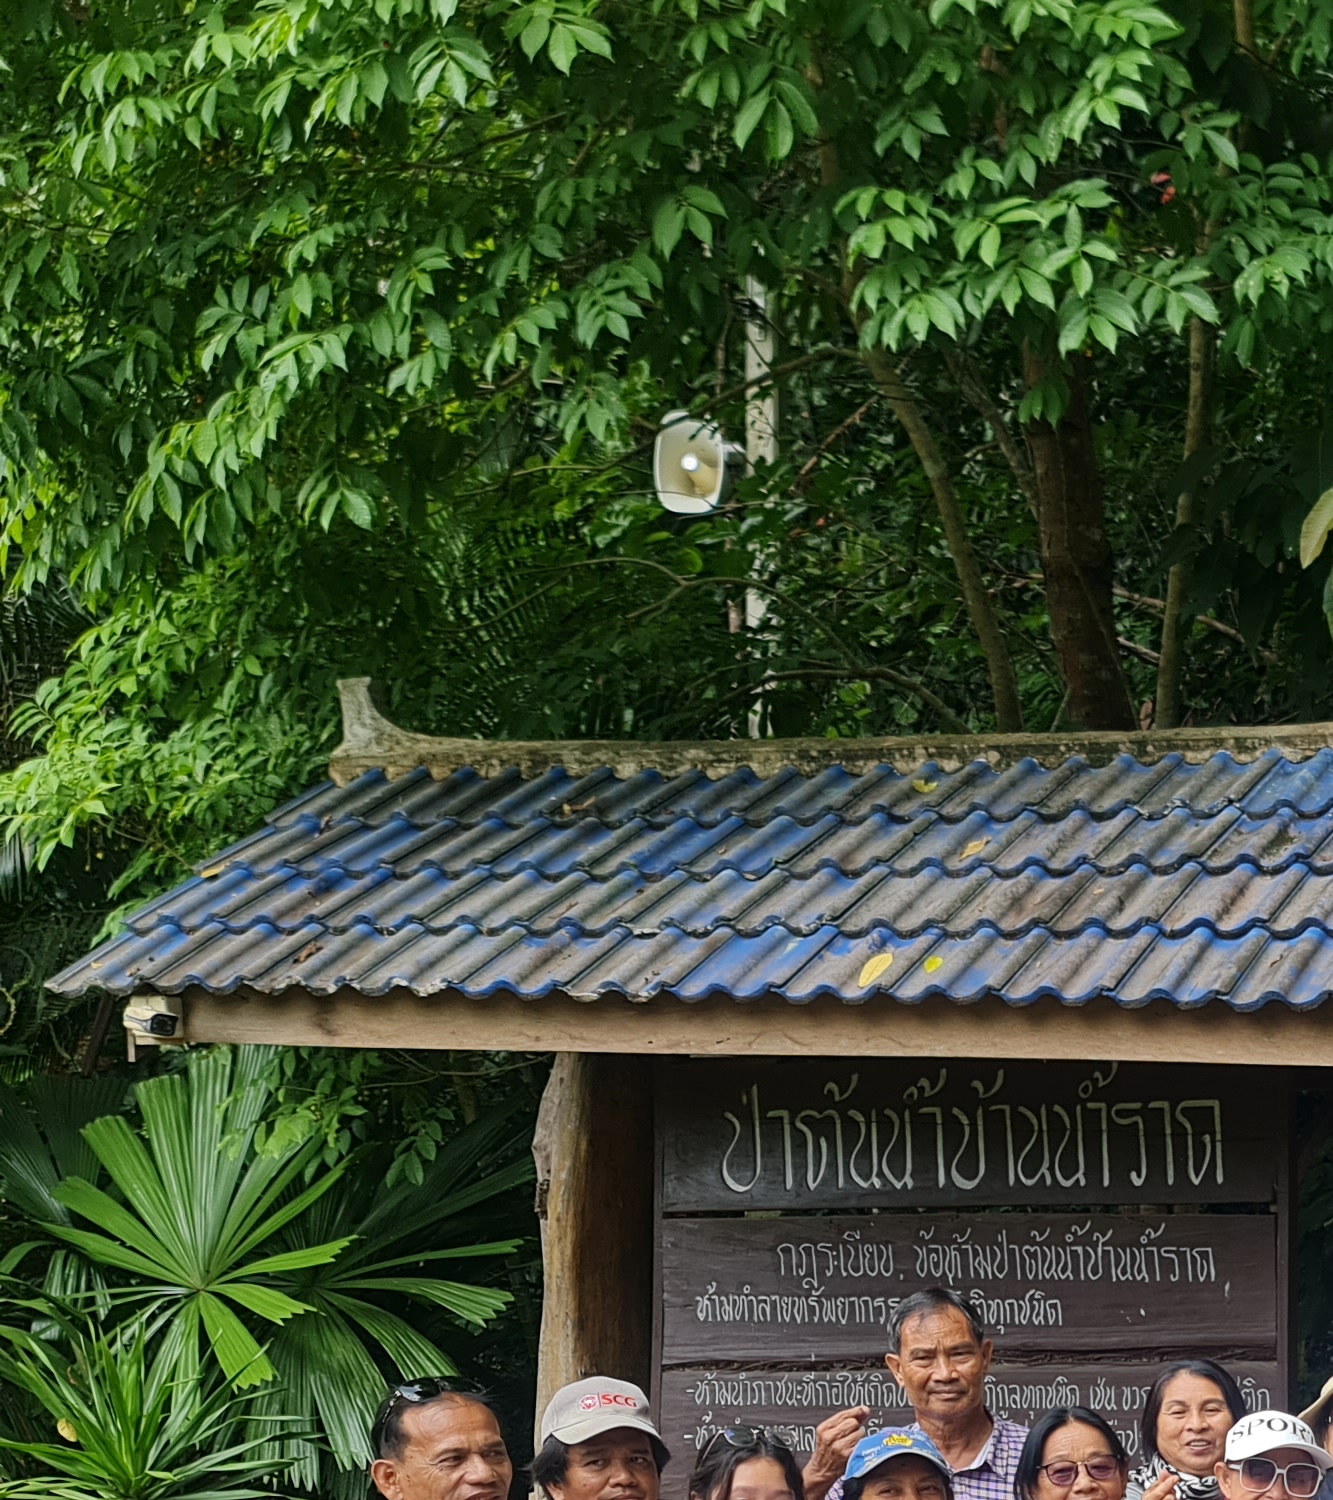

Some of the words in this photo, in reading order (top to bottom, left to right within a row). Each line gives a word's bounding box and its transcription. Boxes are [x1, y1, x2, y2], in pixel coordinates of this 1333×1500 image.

[721, 1061, 1224, 1193] ป่าต้นน้ำบ้านน้ำราด
[601, 1393, 638, 1408] SCG
[1231, 1418, 1315, 1445] SPORT
